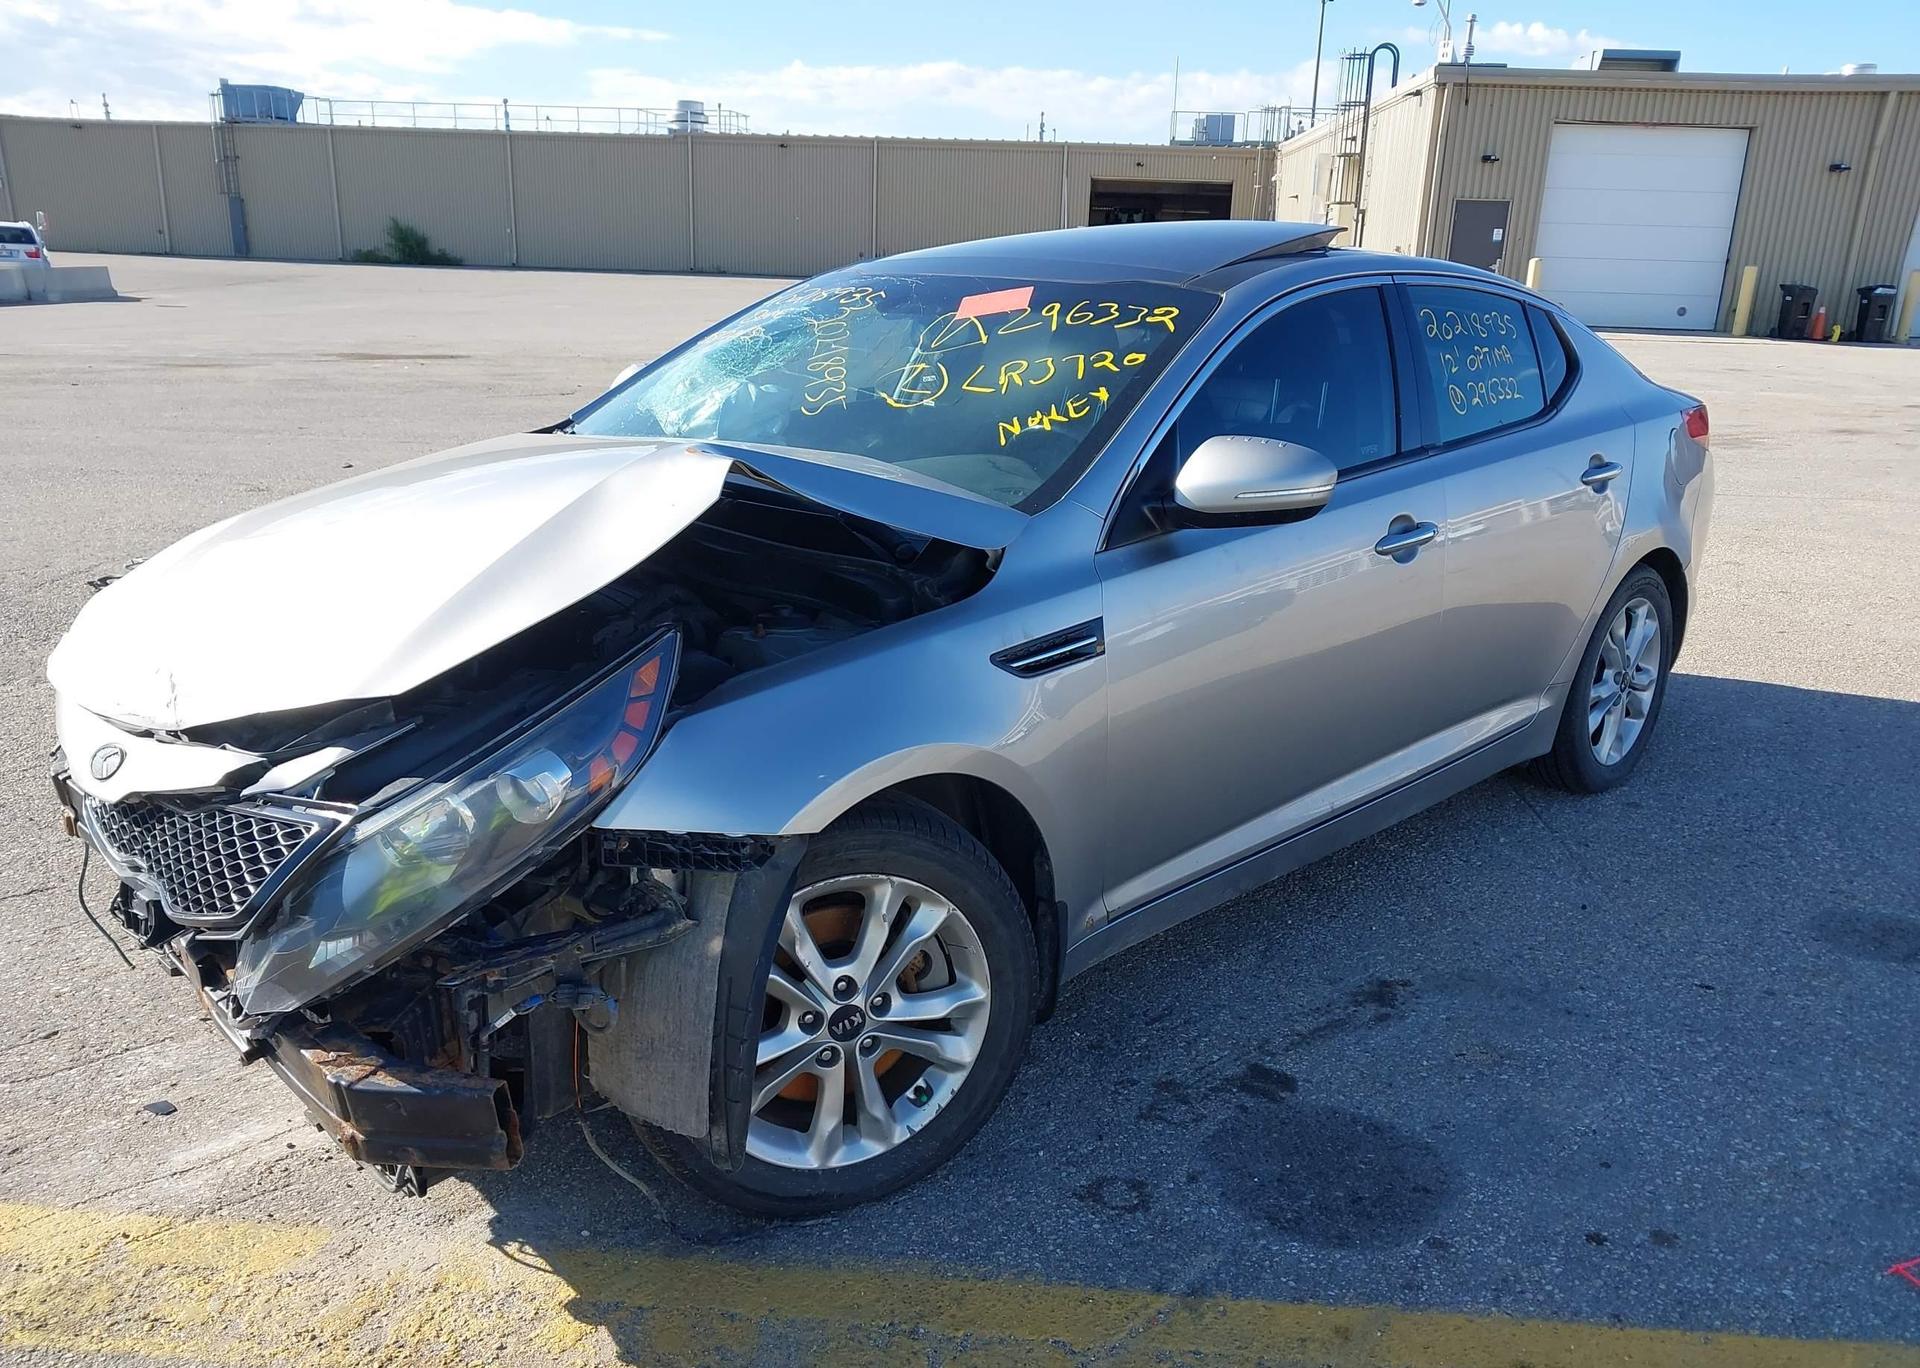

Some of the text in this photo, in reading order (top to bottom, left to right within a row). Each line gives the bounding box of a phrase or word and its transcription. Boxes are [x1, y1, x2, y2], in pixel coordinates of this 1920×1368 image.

[997, 300, 1180, 334] 296332
[1420, 308, 1516, 342] 20218935
[961, 351, 1148, 395] LRJ720
[1466, 344, 1514, 371] OPTIMA
[1467, 377, 1524, 408] 296332
[831, 1012, 863, 1035] KIA
